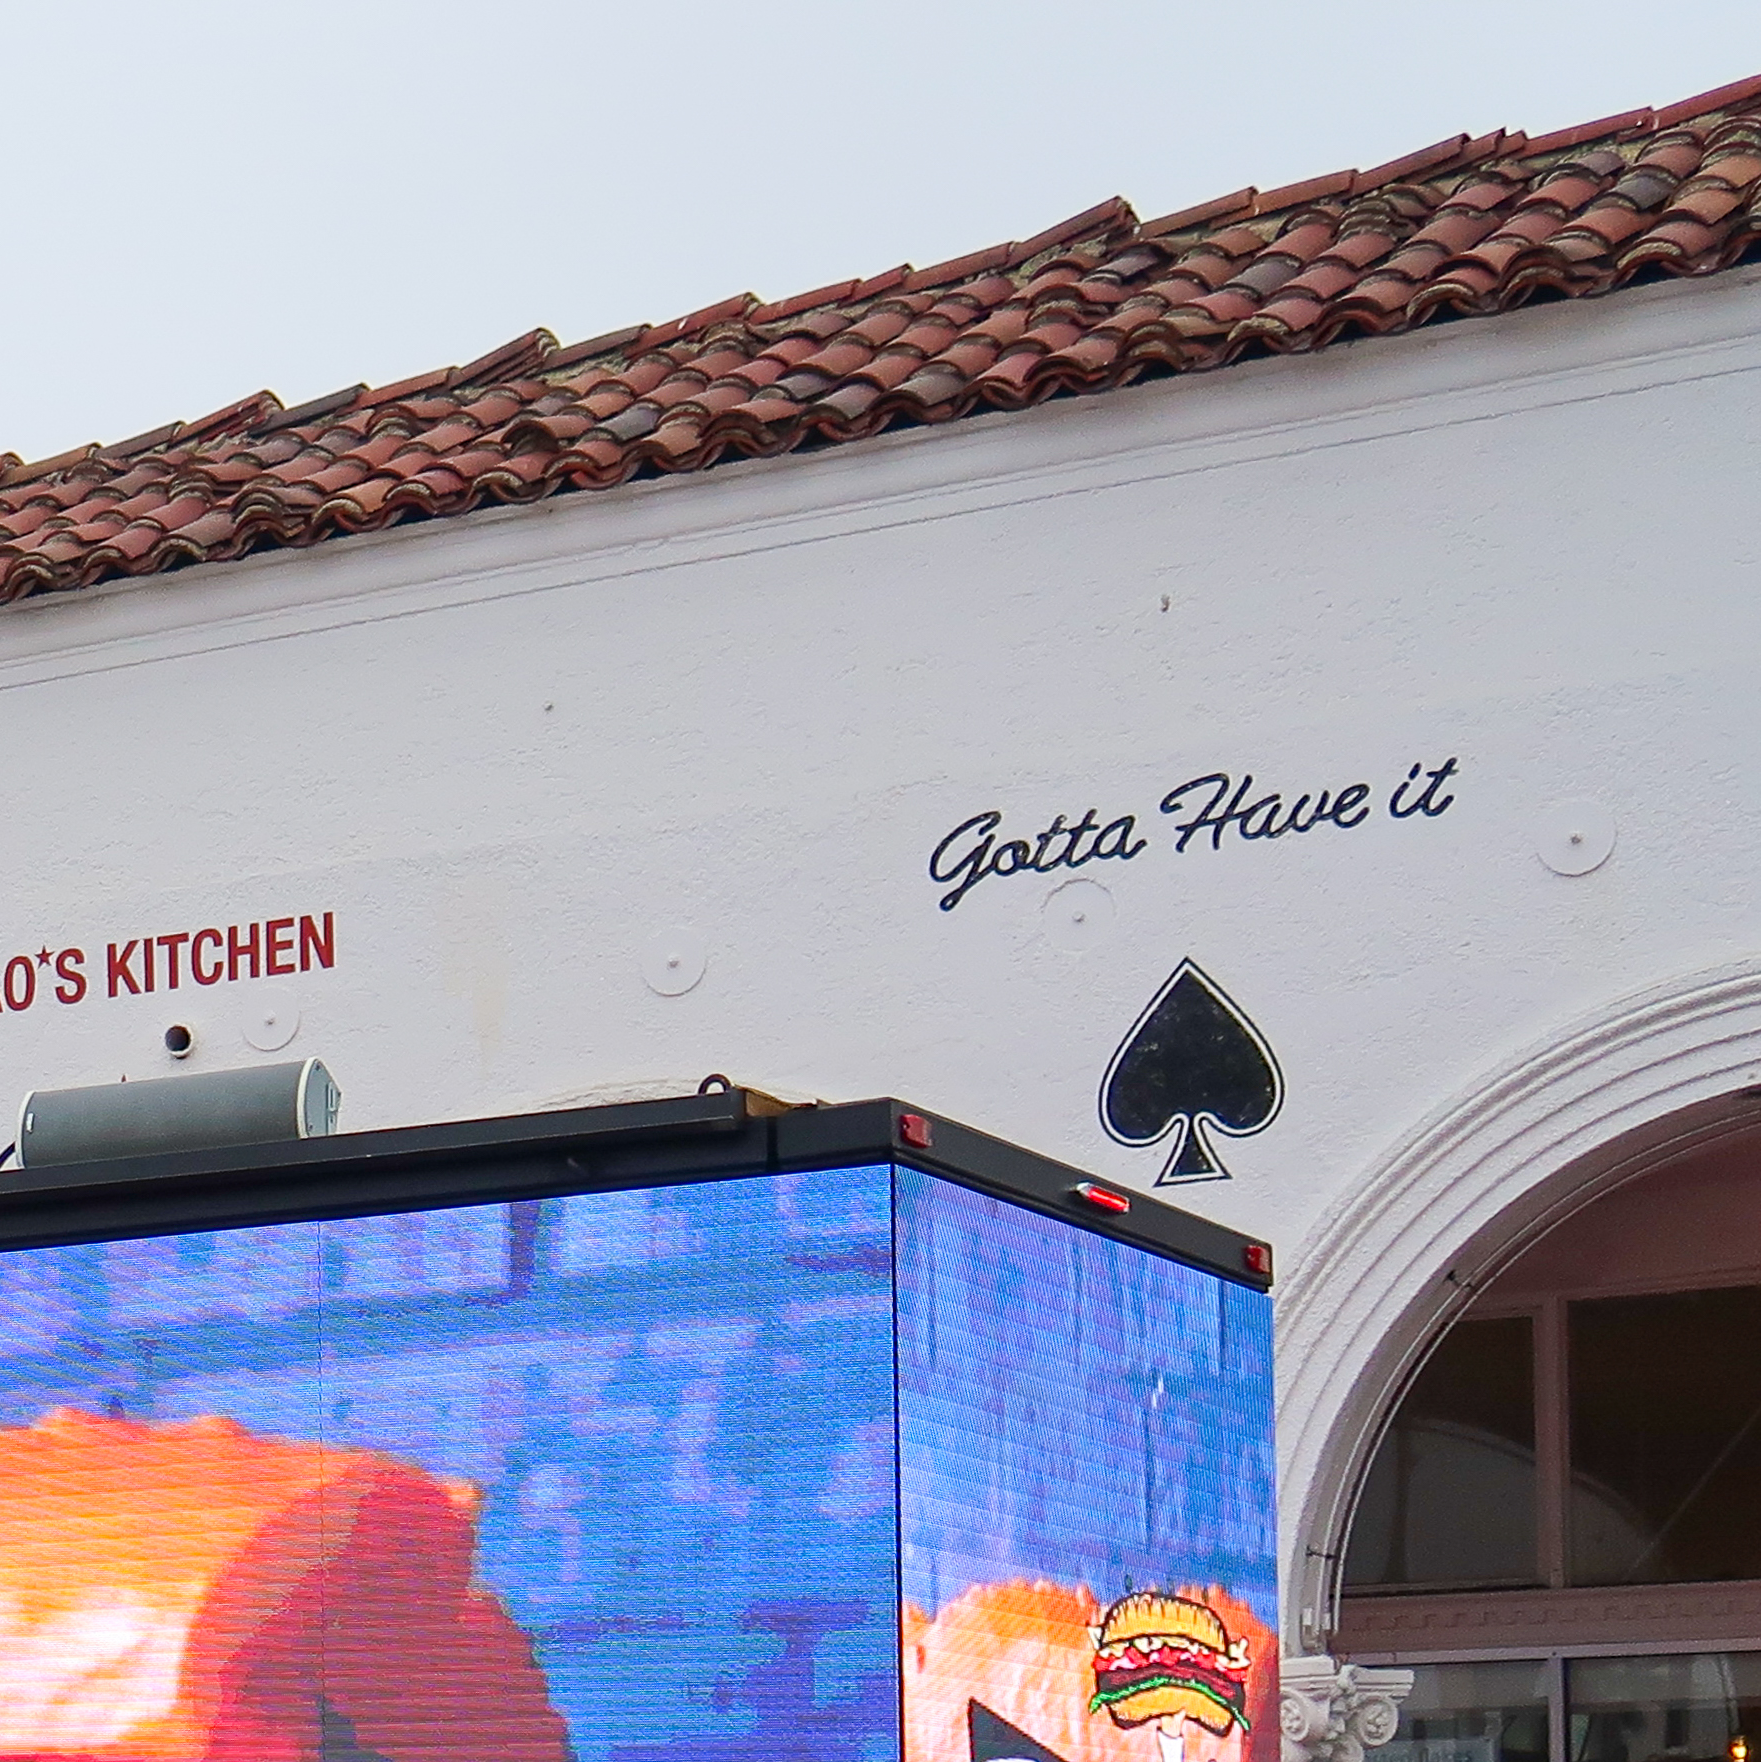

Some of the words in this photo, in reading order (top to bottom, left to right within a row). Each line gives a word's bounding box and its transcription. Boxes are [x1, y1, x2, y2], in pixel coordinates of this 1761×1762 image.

[929, 808, 1146, 911] Gotta
[1159, 772, 1370, 853] Have
[1388, 757, 1458, 819] it
[106, 911, 335, 998] KITCHEN
